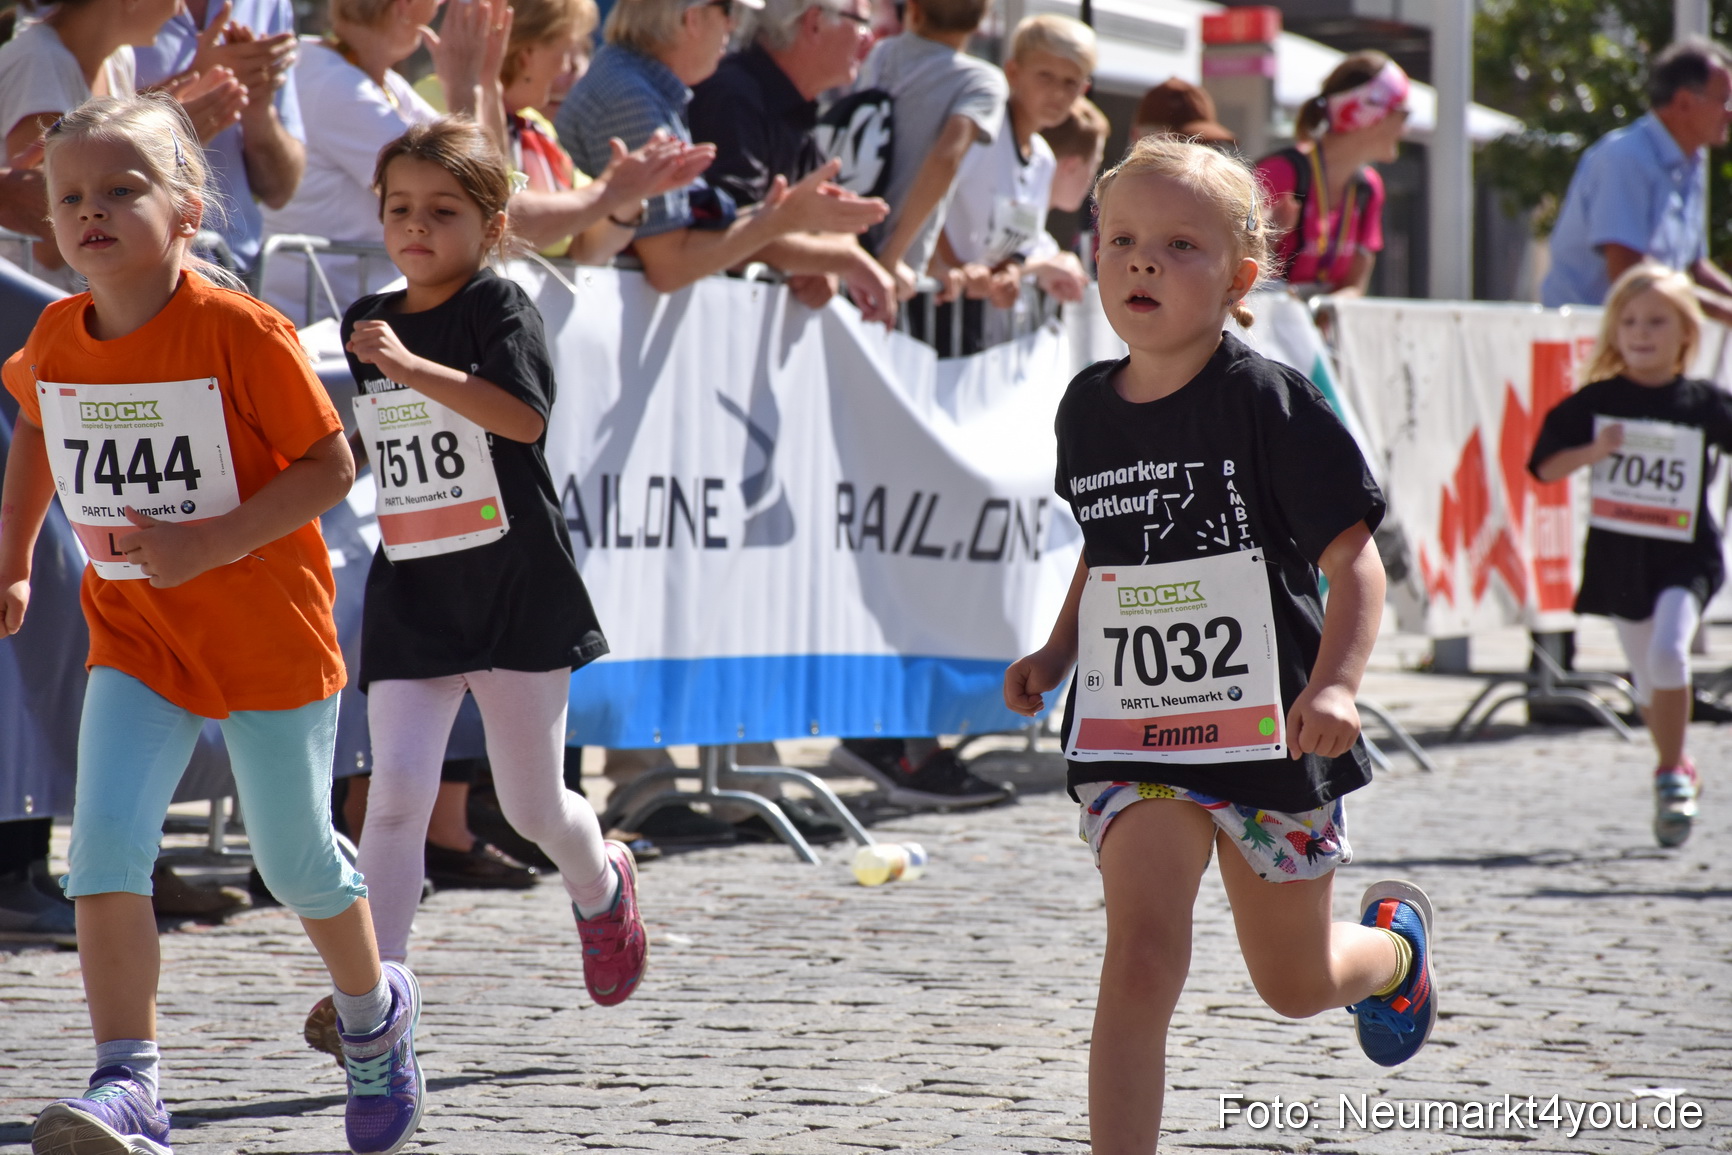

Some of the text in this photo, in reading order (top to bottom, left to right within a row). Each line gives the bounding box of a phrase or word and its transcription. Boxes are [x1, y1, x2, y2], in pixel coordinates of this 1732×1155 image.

[79, 400, 162, 422] BOCK
[378, 402, 430, 424] BOCK
[81, 422, 103, 430] inspired
[105, 422, 112, 430] by
[134, 421, 164, 429] concepts
[63, 435, 201, 496] 7444
[376, 430, 465, 488] 7518
[1608, 452, 1686, 491] 7045
[385, 490, 448, 507] PARTL Neumarkt
[82, 505, 115, 517] PARTL
[836, 481, 1048, 562] RAIL.ONE
[1118, 580, 1206, 608] BOCK
[1119, 602, 1208, 617] inspired by smart concepts
[1103, 616, 1249, 686] 7032
[1087, 675, 1100, 687] B1
[1121, 691, 1224, 710] PARTL Neumarkt
[1142, 723, 1218, 747] Emma
